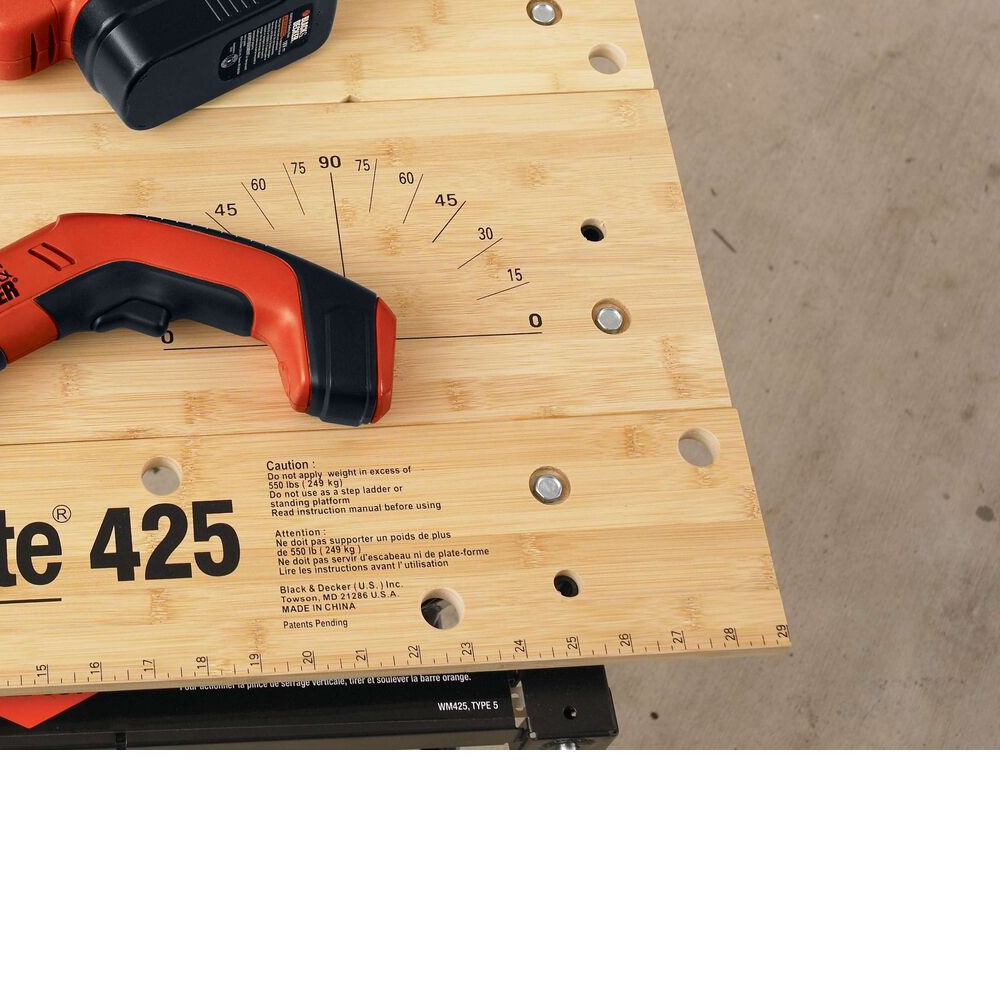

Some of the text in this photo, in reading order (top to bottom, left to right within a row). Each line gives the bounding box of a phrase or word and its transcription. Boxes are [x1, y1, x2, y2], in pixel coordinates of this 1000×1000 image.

[291, 161, 307, 175] 75
[318, 155, 342, 169] 90
[355, 158, 371, 172] 75
[250, 178, 267, 192] 60
[399, 171, 415, 185] 60
[435, 193, 458, 207] 45
[214, 203, 238, 217] 45
[478, 226, 494, 241] 30
[507, 267, 523, 282] 15
[528, 312, 543, 328] 0
[266, 460, 309, 471] Caution
[267, 465, 412, 481] Do not apply weight in excess of
[268, 481, 284, 490] 550
[286, 480, 300, 489] lbs
[269, 490, 282, 499] Do
[284, 490, 299, 498] not
[341, 487, 361, 496] step
[362, 484, 390, 494] ladder
[393, 485, 403, 493] or
[270, 496, 351, 508] standing platform
[271, 500, 442, 517] Read instruction manual before using
[275, 528, 321, 538] Attention
[276, 530, 452, 548] Ne doit pas supporter un poids de plus
[90, 499, 241, 582] 425
[277, 548, 288, 557] de
[290, 547, 306, 556] 550
[308, 546, 317, 555] lb
[278, 557, 290, 566] Ne
[292, 556, 311, 566] doit
[312, 556, 329, 567] pas
[331, 554, 358, 564] servir
[413, 550, 423, 560] ni
[424, 550, 436, 559] de
[438, 547, 490, 559] plate-forme
[279, 566, 297, 576] Lire
[299, 565, 312, 575] les
[314, 562, 369, 574] instructions
[370, 562, 396, 571] avant
[279, 584, 307, 594] Black
[308, 584, 316, 593] &
[317, 582, 351, 592] Decker
[322, 592, 338, 601] MD
[340, 591, 368, 600] 21286
[282, 602, 356, 613] MADE IN CHINA
[283, 618, 349, 629] Patents Pending
[37, 665, 47, 678] 15
[90, 662, 100, 675] 16
[143, 660, 154, 673] 17
[197, 657, 207, 669] 18
[250, 654, 261, 667] 19
[302, 651, 313, 664] 20
[356, 649, 367, 662] 21
[409, 645, 420, 658] 22
[462, 643, 472, 656] 23
[515, 639, 525, 653] 24
[568, 636, 578, 650] 25
[620, 633, 631, 647] 26
[672, 631, 683, 644] 27
[724, 628, 735, 641] 28
[777, 625, 788, 638] 29
[471, 701, 492, 710] TYPE
[493, 700, 499, 710] 5
